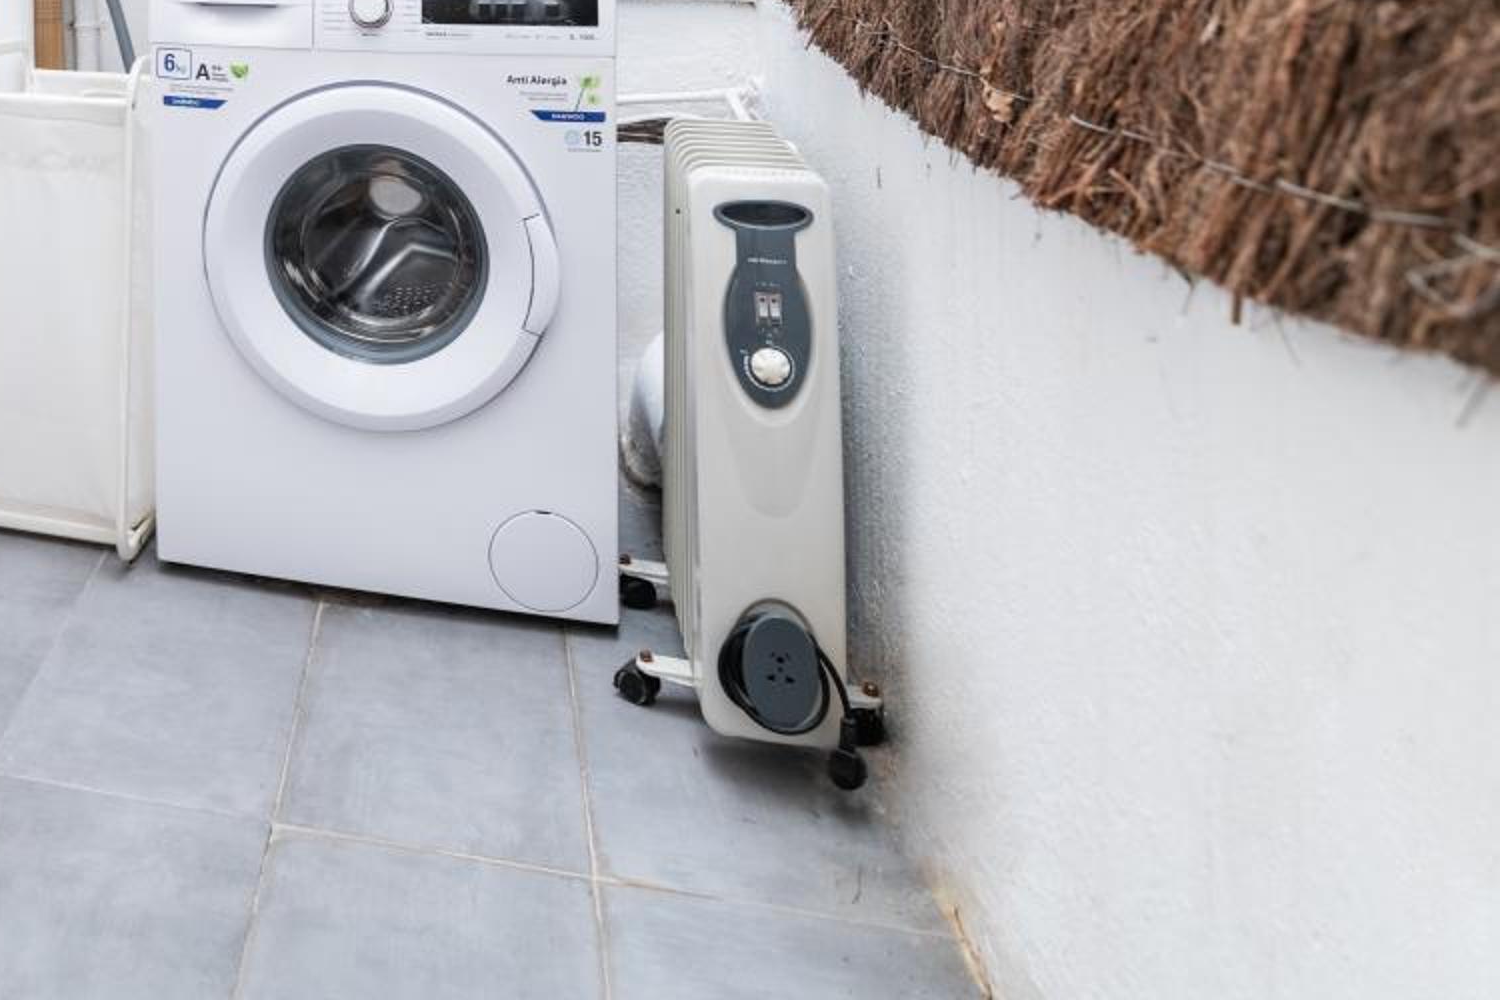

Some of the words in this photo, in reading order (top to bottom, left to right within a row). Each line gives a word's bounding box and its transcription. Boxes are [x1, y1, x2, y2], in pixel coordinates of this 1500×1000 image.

[506, 75, 529, 85] Anti
[530, 75, 567, 87] Alergia
[584, 130, 603, 147] 15
